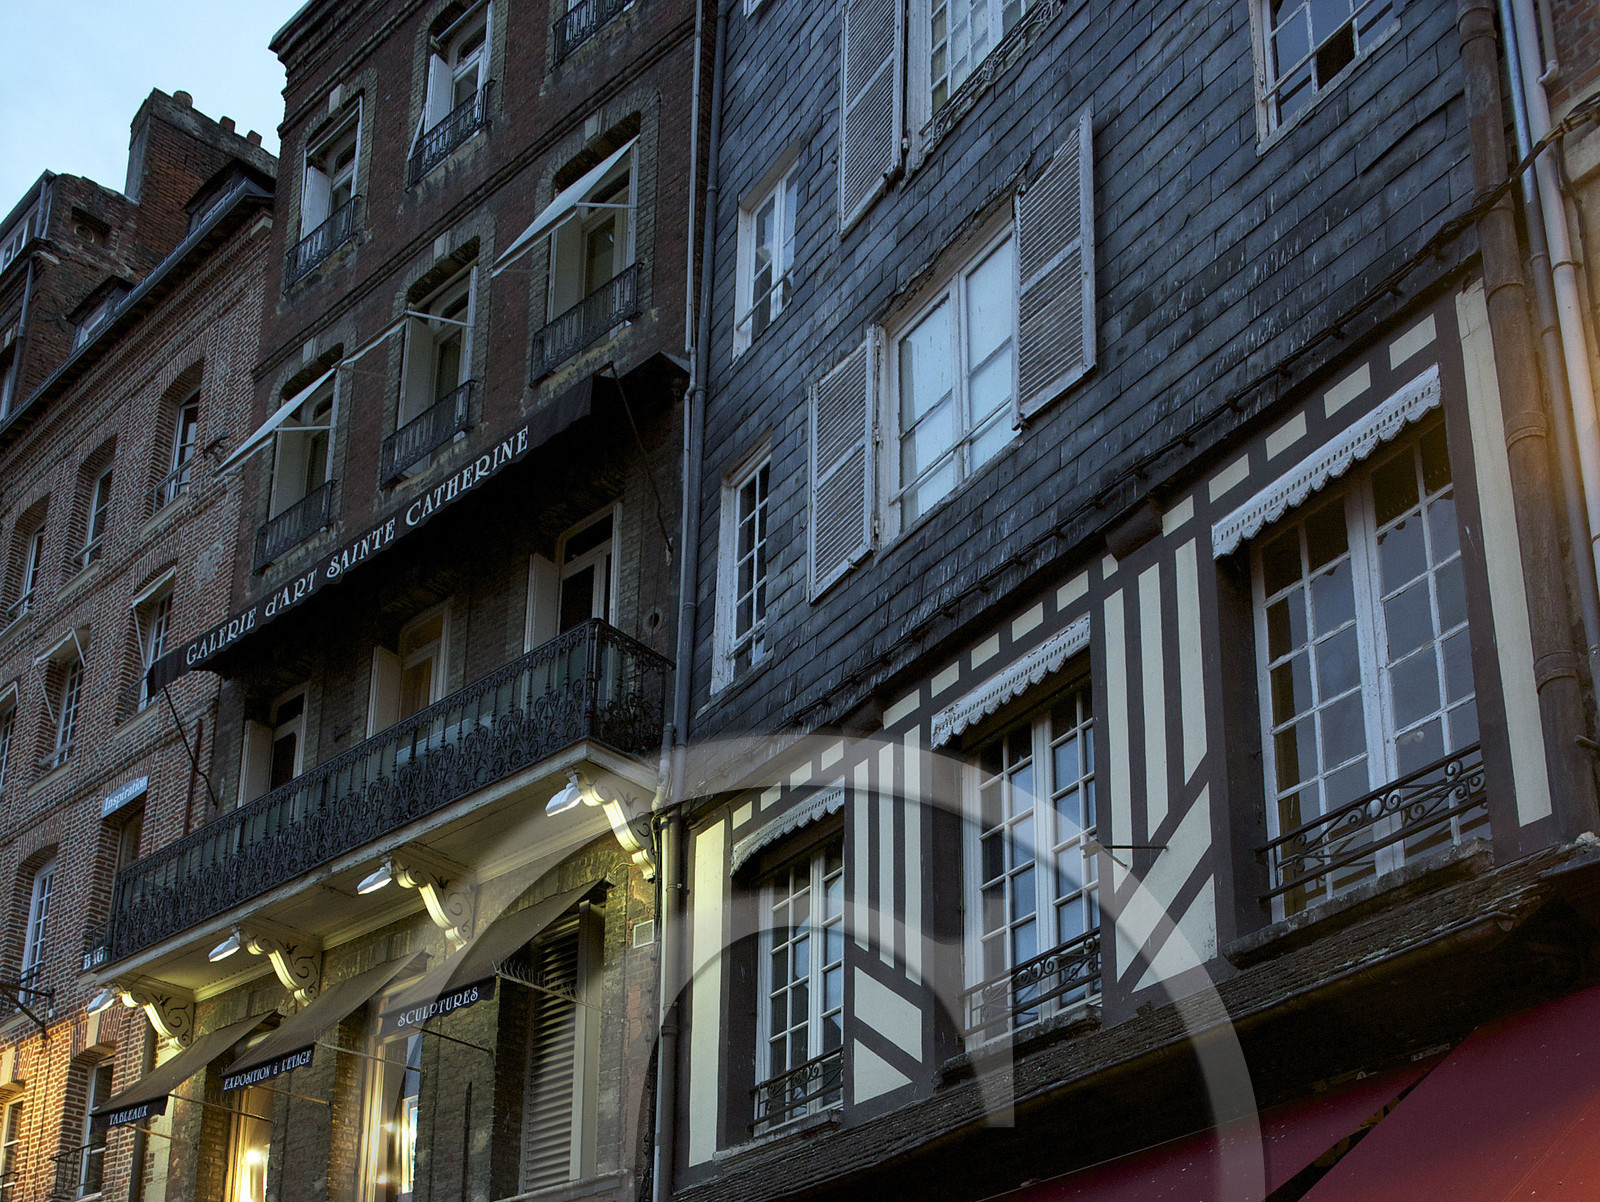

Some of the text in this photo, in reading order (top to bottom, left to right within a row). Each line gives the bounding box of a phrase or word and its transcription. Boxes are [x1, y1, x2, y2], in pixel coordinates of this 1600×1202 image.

[186, 425, 530, 665] GALERIE d'ART SAINTE CATHERINE
[104, 776, 147, 811] Inspiration
[396, 983, 480, 1028] SCULPTURES
[223, 1066, 270, 1091] EXPOSITION
[280, 1049, 312, 1077] L'ETAGE
[108, 1105, 148, 1126] TABLEAUX
